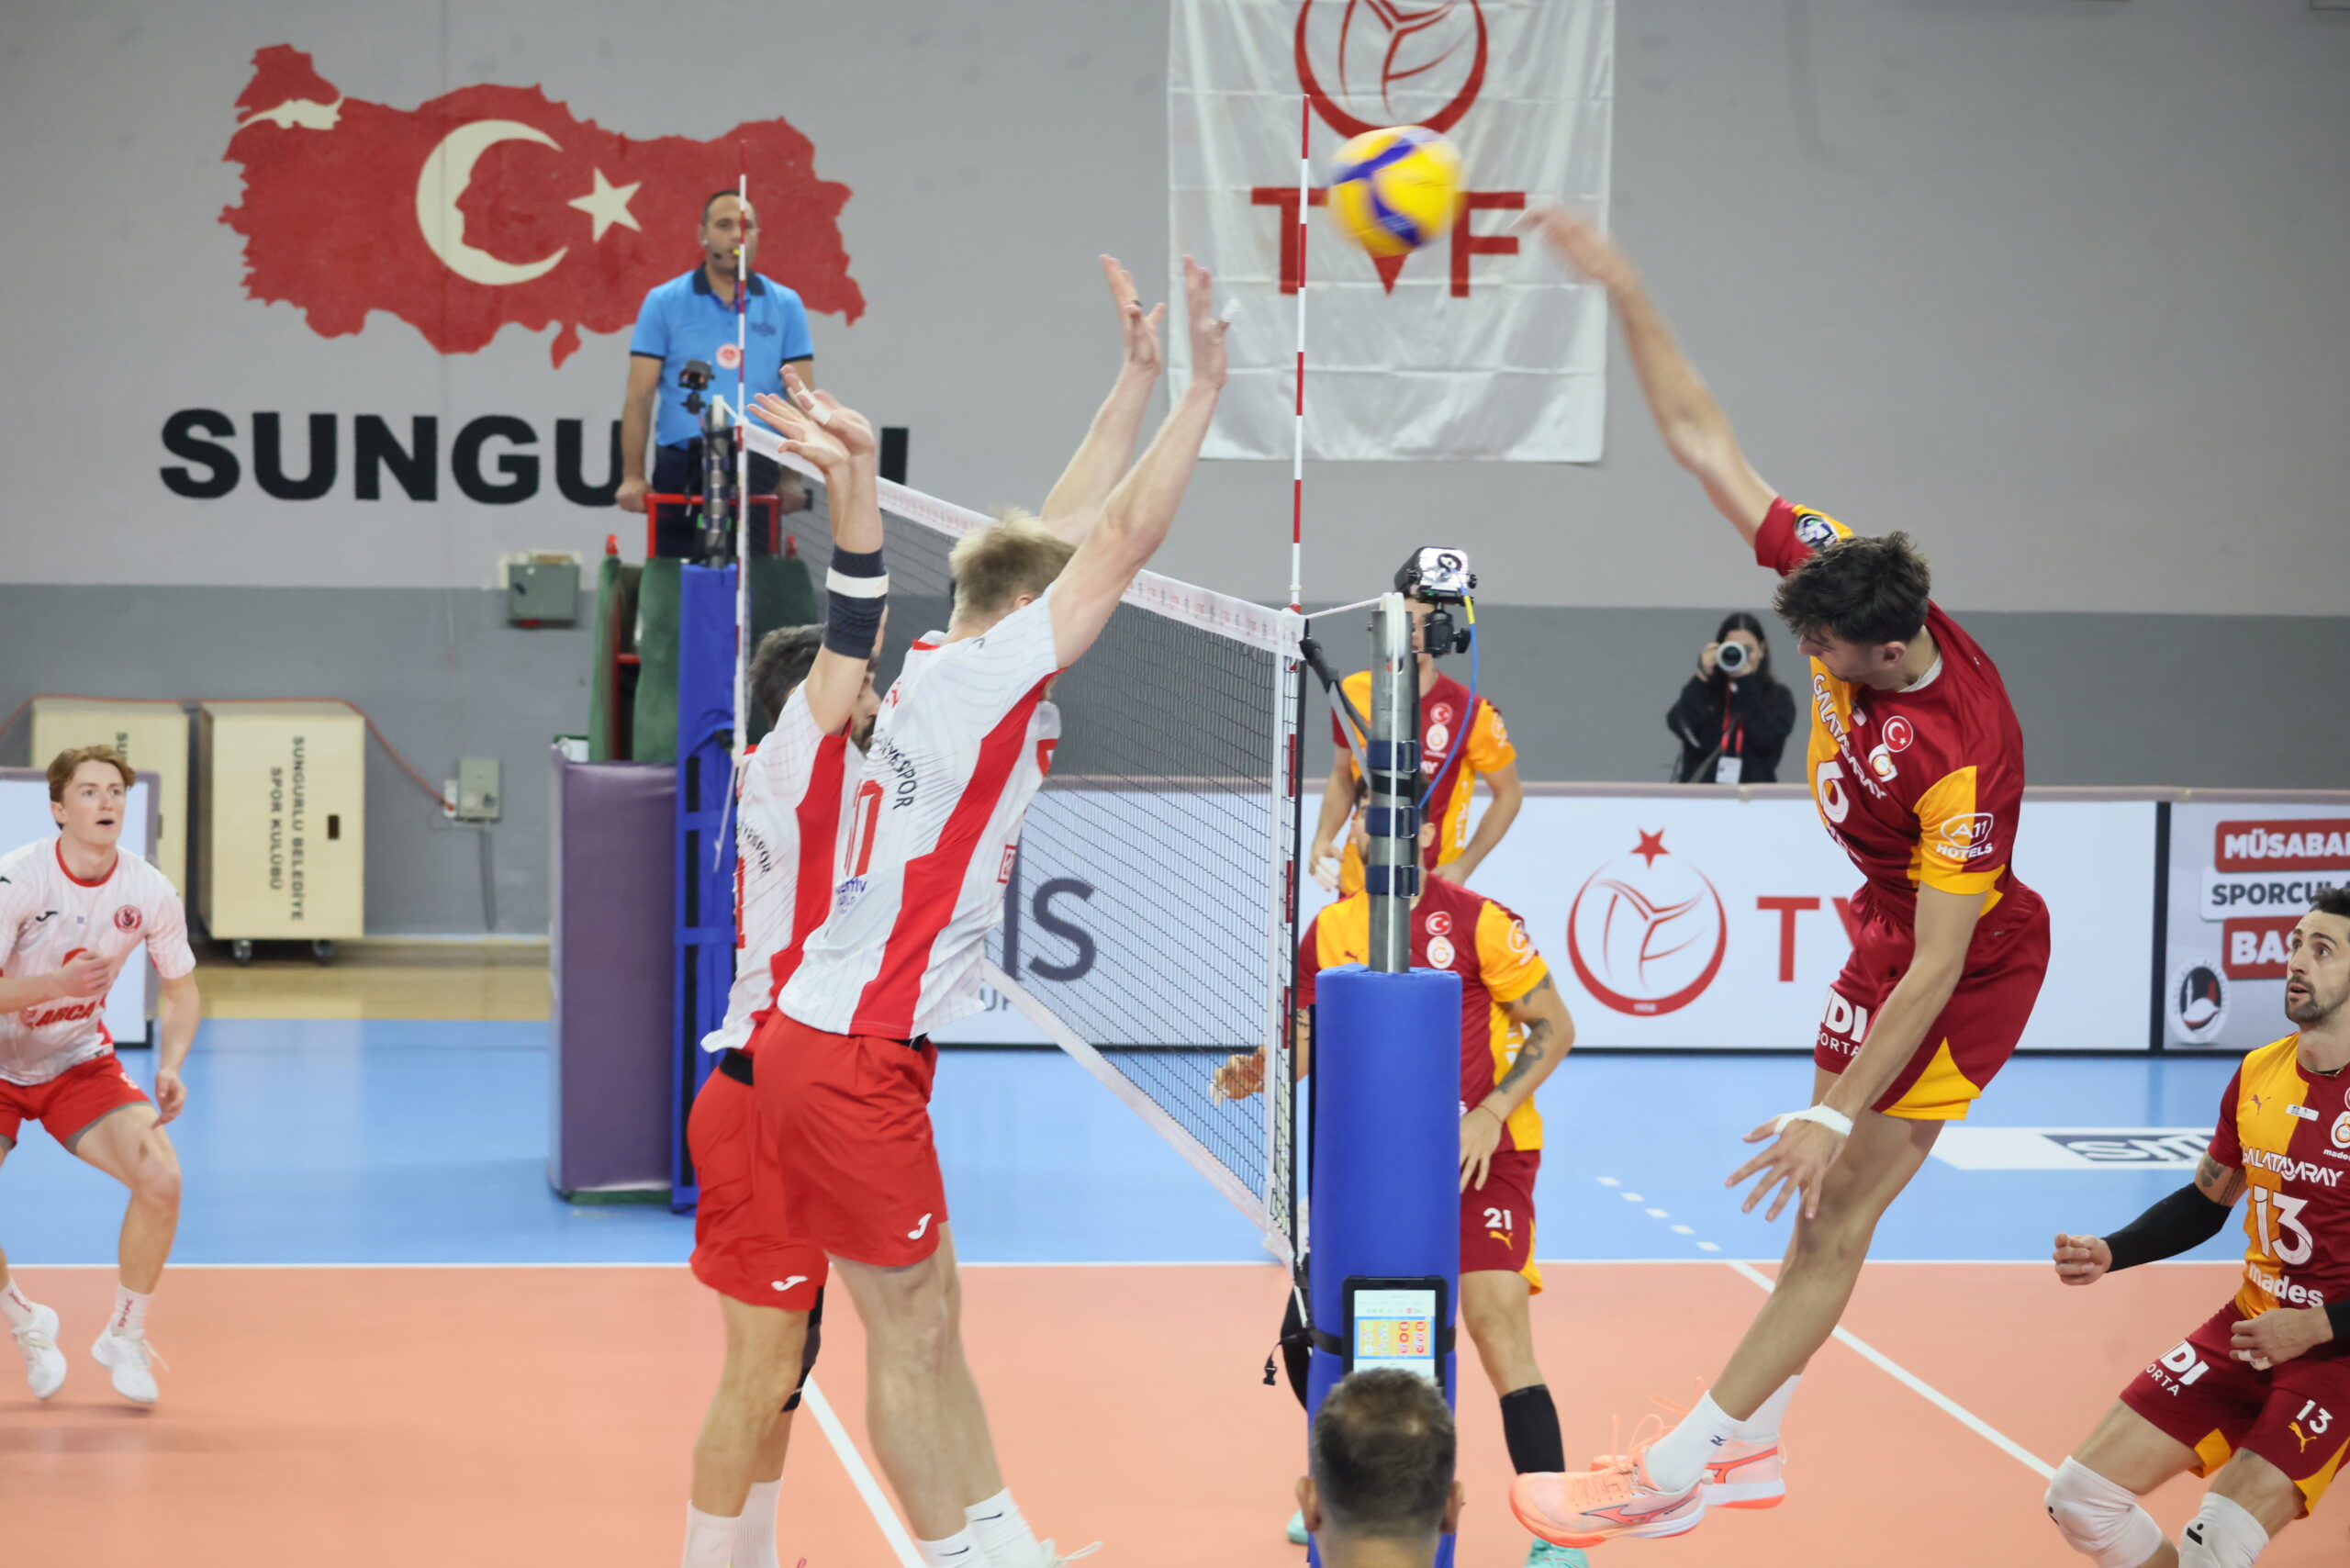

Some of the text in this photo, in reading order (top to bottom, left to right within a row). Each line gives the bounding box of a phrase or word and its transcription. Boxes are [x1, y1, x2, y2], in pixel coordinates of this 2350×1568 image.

[1251, 187, 1525, 297] TF
[270, 767, 283, 812] SPOR
[1817, 761, 1849, 823] 6
[1936, 843, 1993, 859] HOTELS
[2224, 828, 2350, 859] MÜSABA
[1818, 1032, 1861, 1057] ORTA
[2242, 1146, 2344, 1187] GALATASARAY
[2323, 1148, 2350, 1161] made
[1483, 1207, 1513, 1230] 21
[2253, 1184, 2313, 1266] 13
[2249, 1262, 2324, 1307] mades
[2160, 1339, 2210, 1385] DI
[2296, 1399, 2333, 1434] 13
